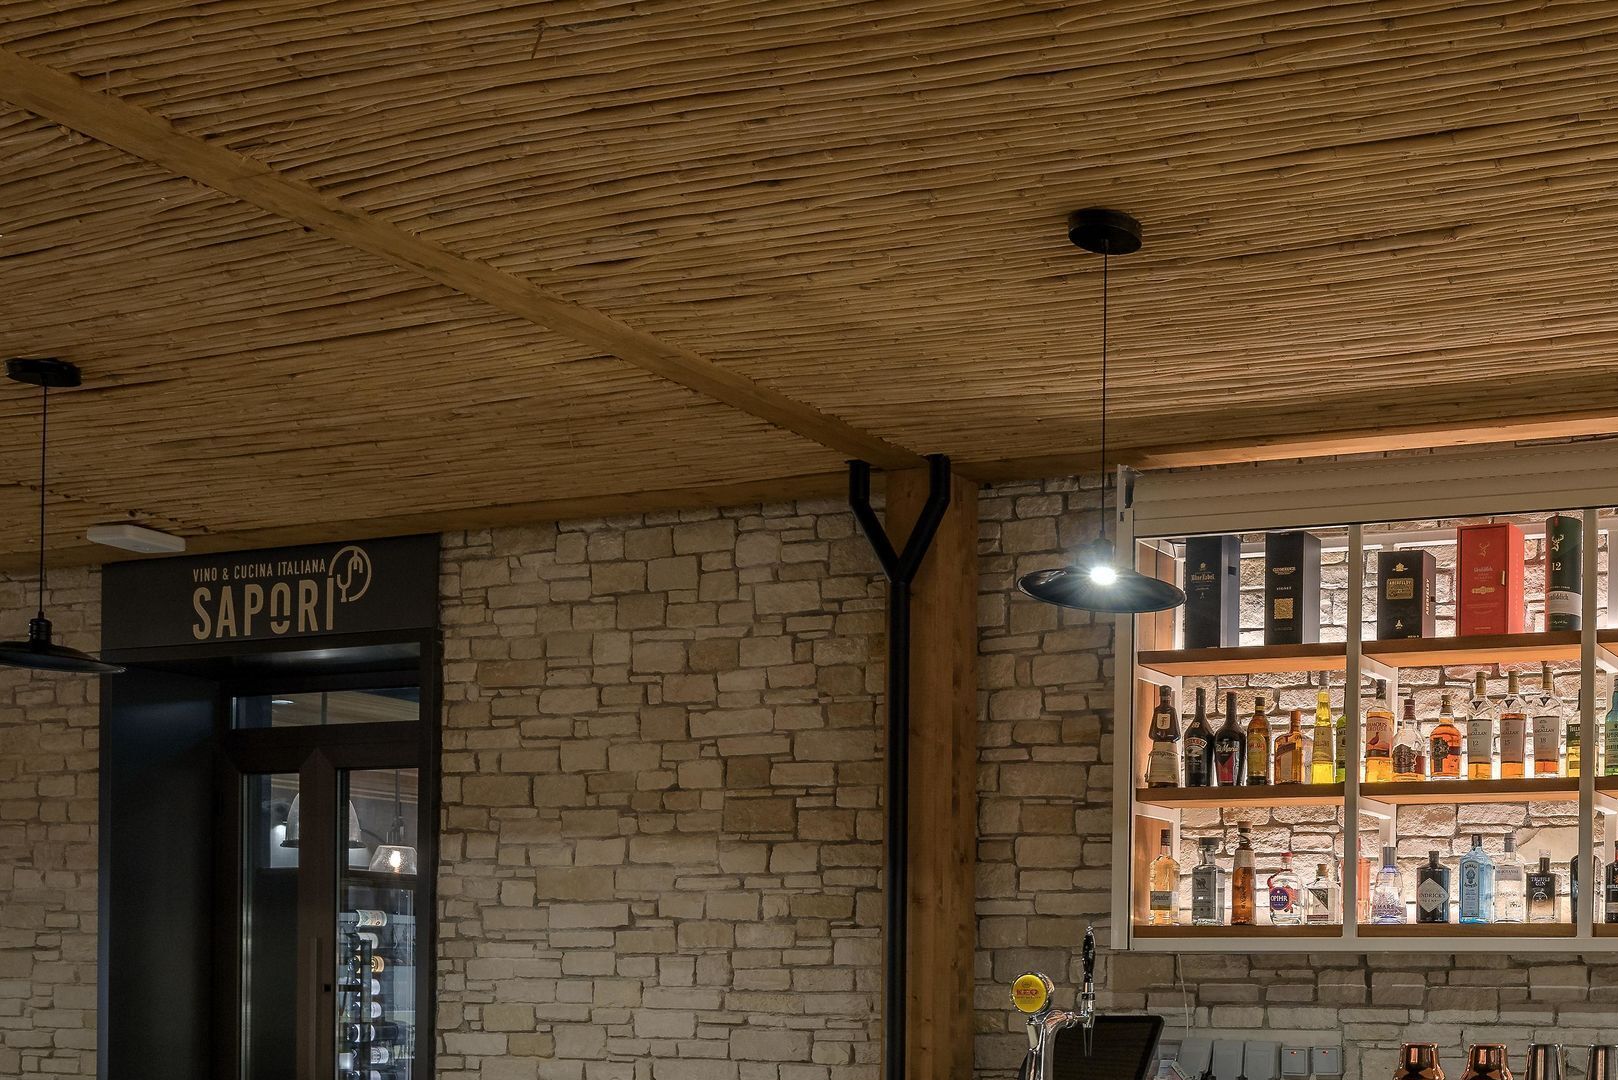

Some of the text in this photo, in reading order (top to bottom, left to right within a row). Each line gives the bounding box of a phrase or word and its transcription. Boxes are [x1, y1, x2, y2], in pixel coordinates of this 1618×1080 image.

[193, 559, 326, 582] VINO & CUCINA ITALIANA
[1551, 562, 1561, 571] 12
[193, 578, 334, 640] SAPORI
